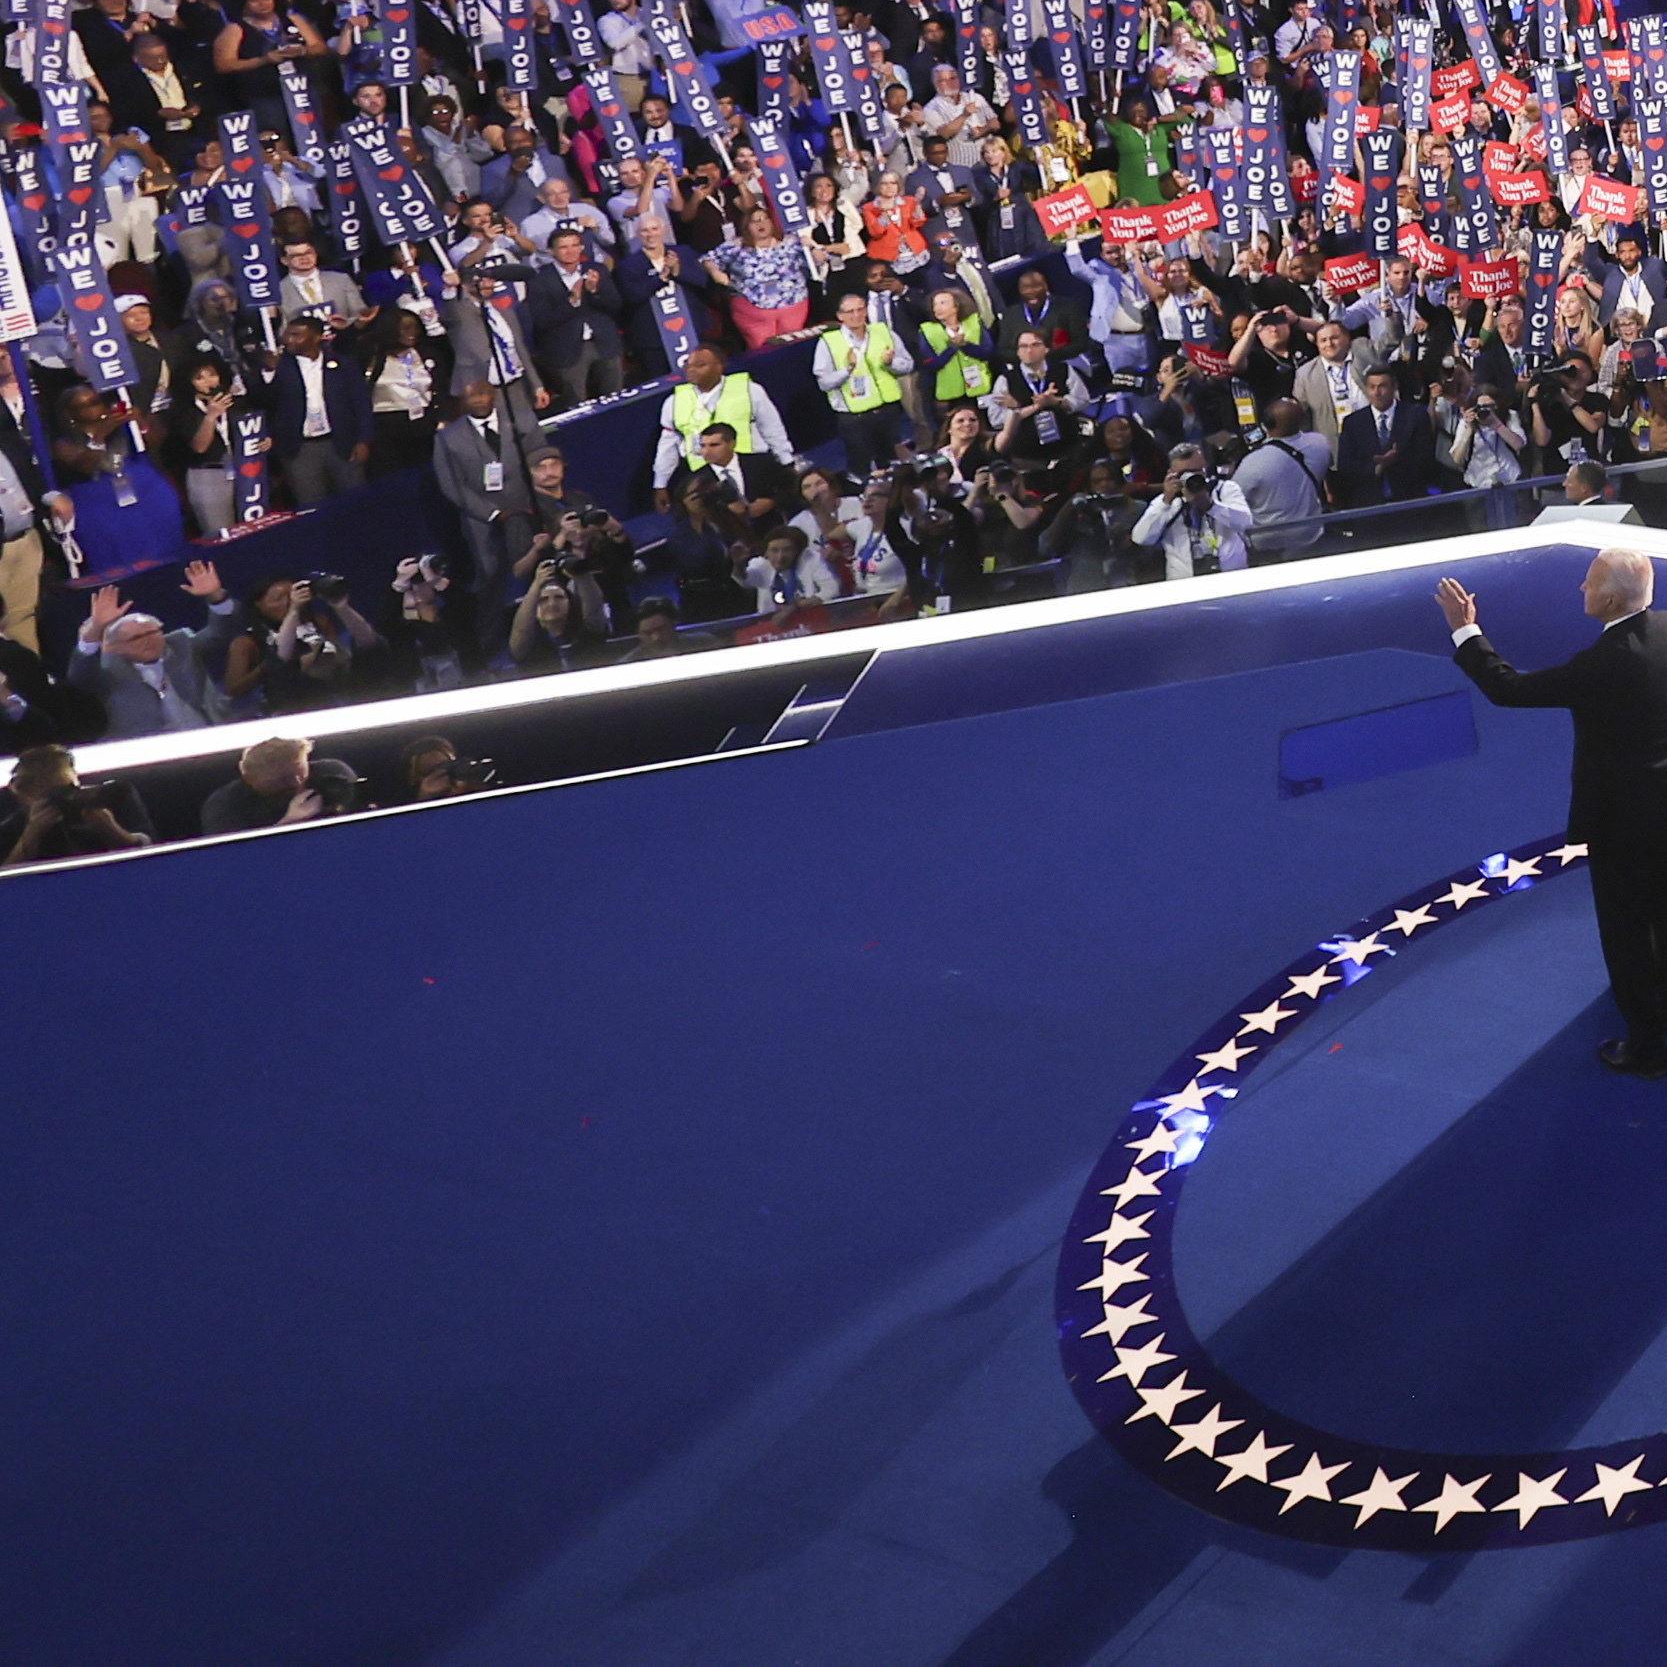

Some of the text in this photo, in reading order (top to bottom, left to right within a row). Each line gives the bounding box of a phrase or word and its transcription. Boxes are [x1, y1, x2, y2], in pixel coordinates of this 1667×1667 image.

[1209, 131, 1232, 165] WE
[1110, 215, 1153, 228] Thank
[1221, 185, 1242, 236] JOE
[1109, 225, 1158, 240] You Joe
[57, 247, 98, 291] WE
[89, 316, 126, 381] JOE
